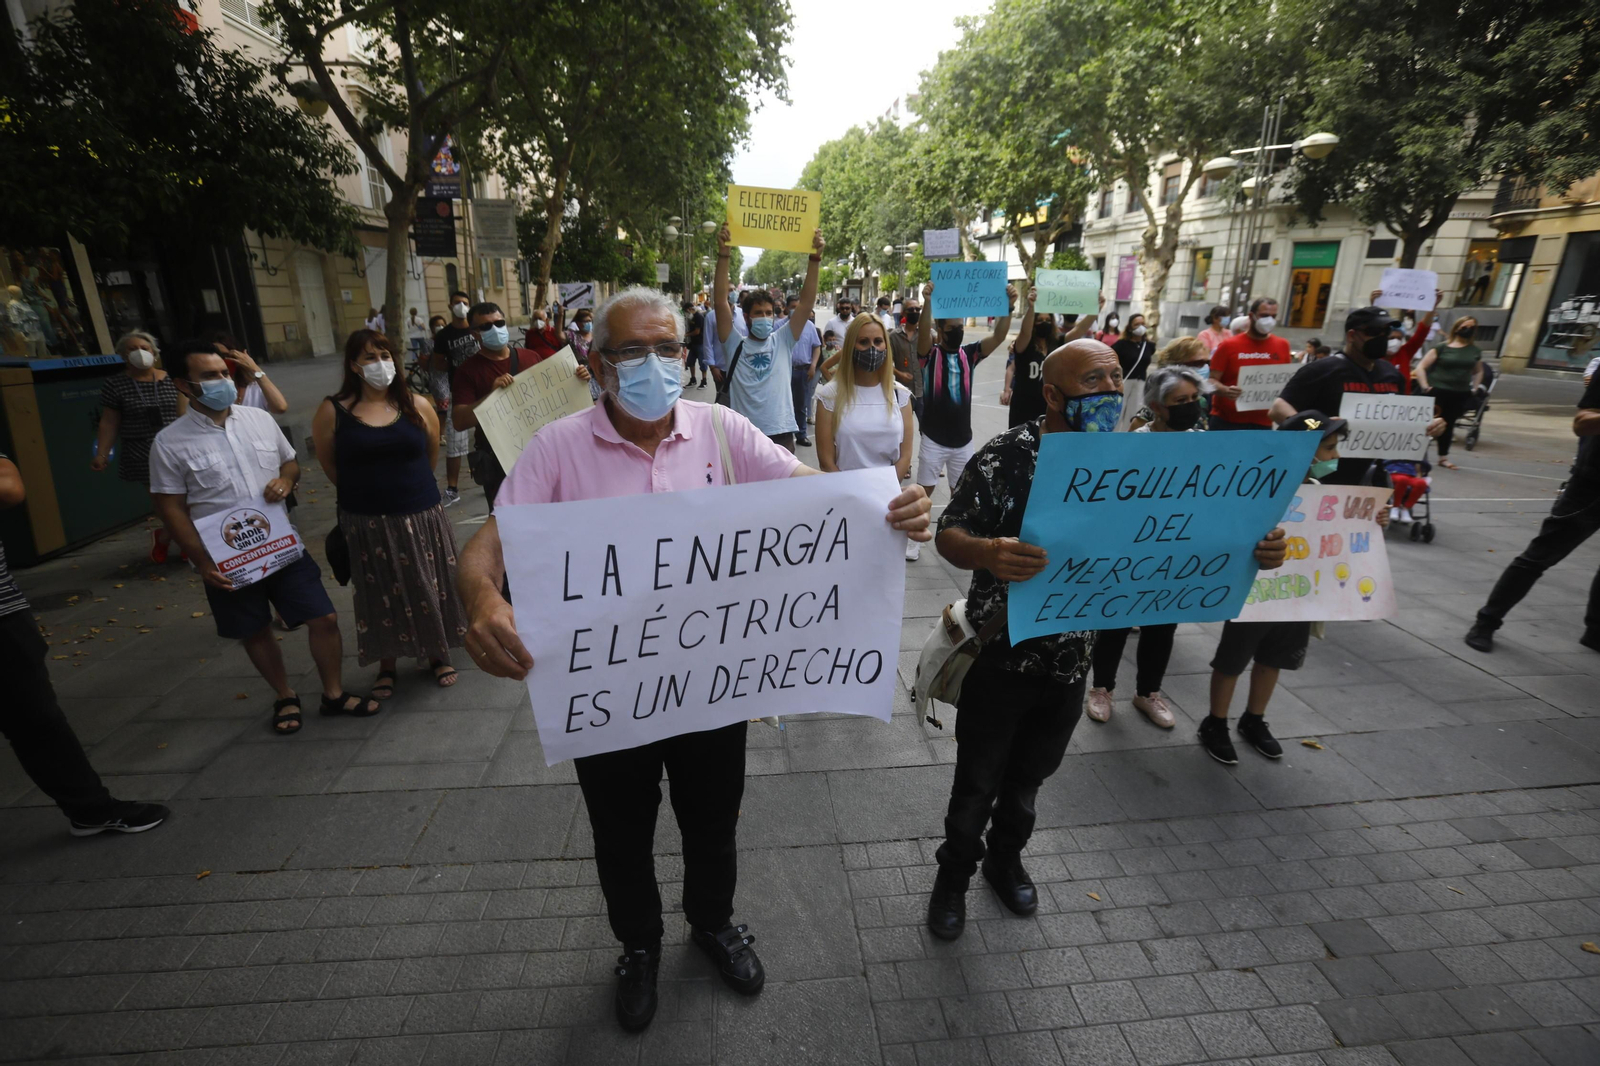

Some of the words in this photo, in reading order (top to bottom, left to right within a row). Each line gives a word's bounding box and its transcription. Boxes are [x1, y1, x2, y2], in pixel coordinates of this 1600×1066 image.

[739, 191, 808, 213] ELECTRICAS
[742, 212, 802, 233] USURERAS
[937, 269, 953, 280] NO
[954, 268, 962, 279] A
[967, 282, 979, 293] DE
[63, 359, 85, 367] PAPEL
[1238, 352, 1271, 360] Reebok
[485, 375, 540, 428] FACTURA
[540, 369, 556, 390] DE
[555, 355, 578, 384] LUZ
[1243, 371, 1264, 386] MÁS
[506, 387, 569, 439] EMBROLLO
[1355, 401, 1432, 423] ELÉCTRICAS
[1063, 455, 1288, 503] REGULACIÓN
[1316, 495, 1339, 521] ES
[234, 527, 263, 542] NADIE
[1133, 513, 1194, 543] DEL
[223, 538, 293, 570] CONCENTRACIÓN
[237, 540, 252, 551] SIN
[252, 534, 267, 545] LUZ
[563, 544, 623, 602] LA
[653, 508, 850, 590] ENERGÍA
[1318, 533, 1344, 559] NO
[1350, 532, 1370, 554] UN
[1048, 553, 1230, 584] MERCADO
[1034, 584, 1231, 623] ELÉCTRICO
[568, 584, 840, 673] ELÉCTRICA
[565, 690, 612, 734] ES
[632, 670, 692, 720] UN
[708, 647, 884, 705] DERECHO
